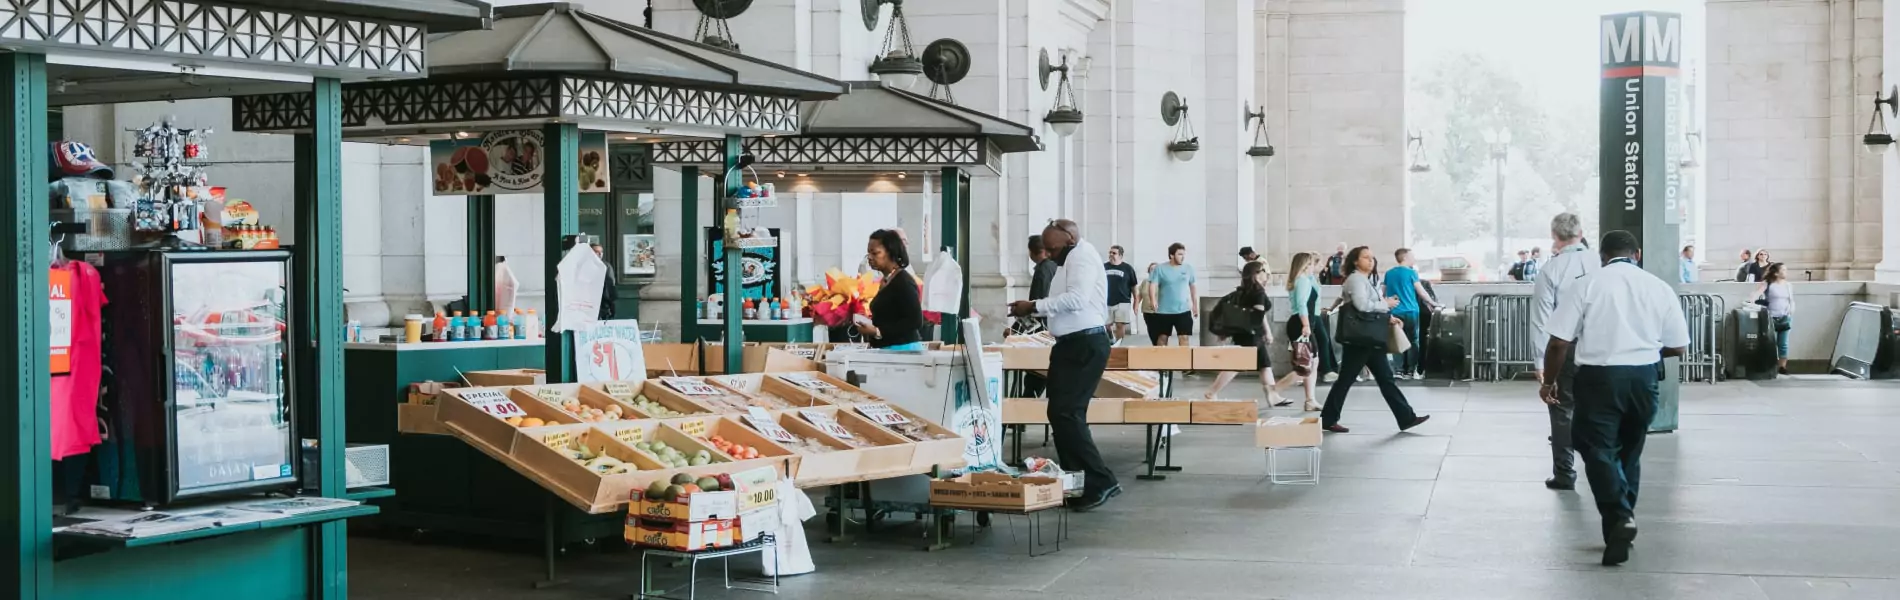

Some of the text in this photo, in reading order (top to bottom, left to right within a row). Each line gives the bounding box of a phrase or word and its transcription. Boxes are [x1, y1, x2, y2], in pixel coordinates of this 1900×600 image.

[1602, 17, 1640, 64] M
[1645, 16, 1679, 63] M
[1625, 78, 1640, 211] Union Station
[1666, 78, 1680, 211] Union Station
[592, 341, 619, 382] $1
[466, 391, 503, 400] SPECIAL
[754, 488, 774, 504] 10.00
